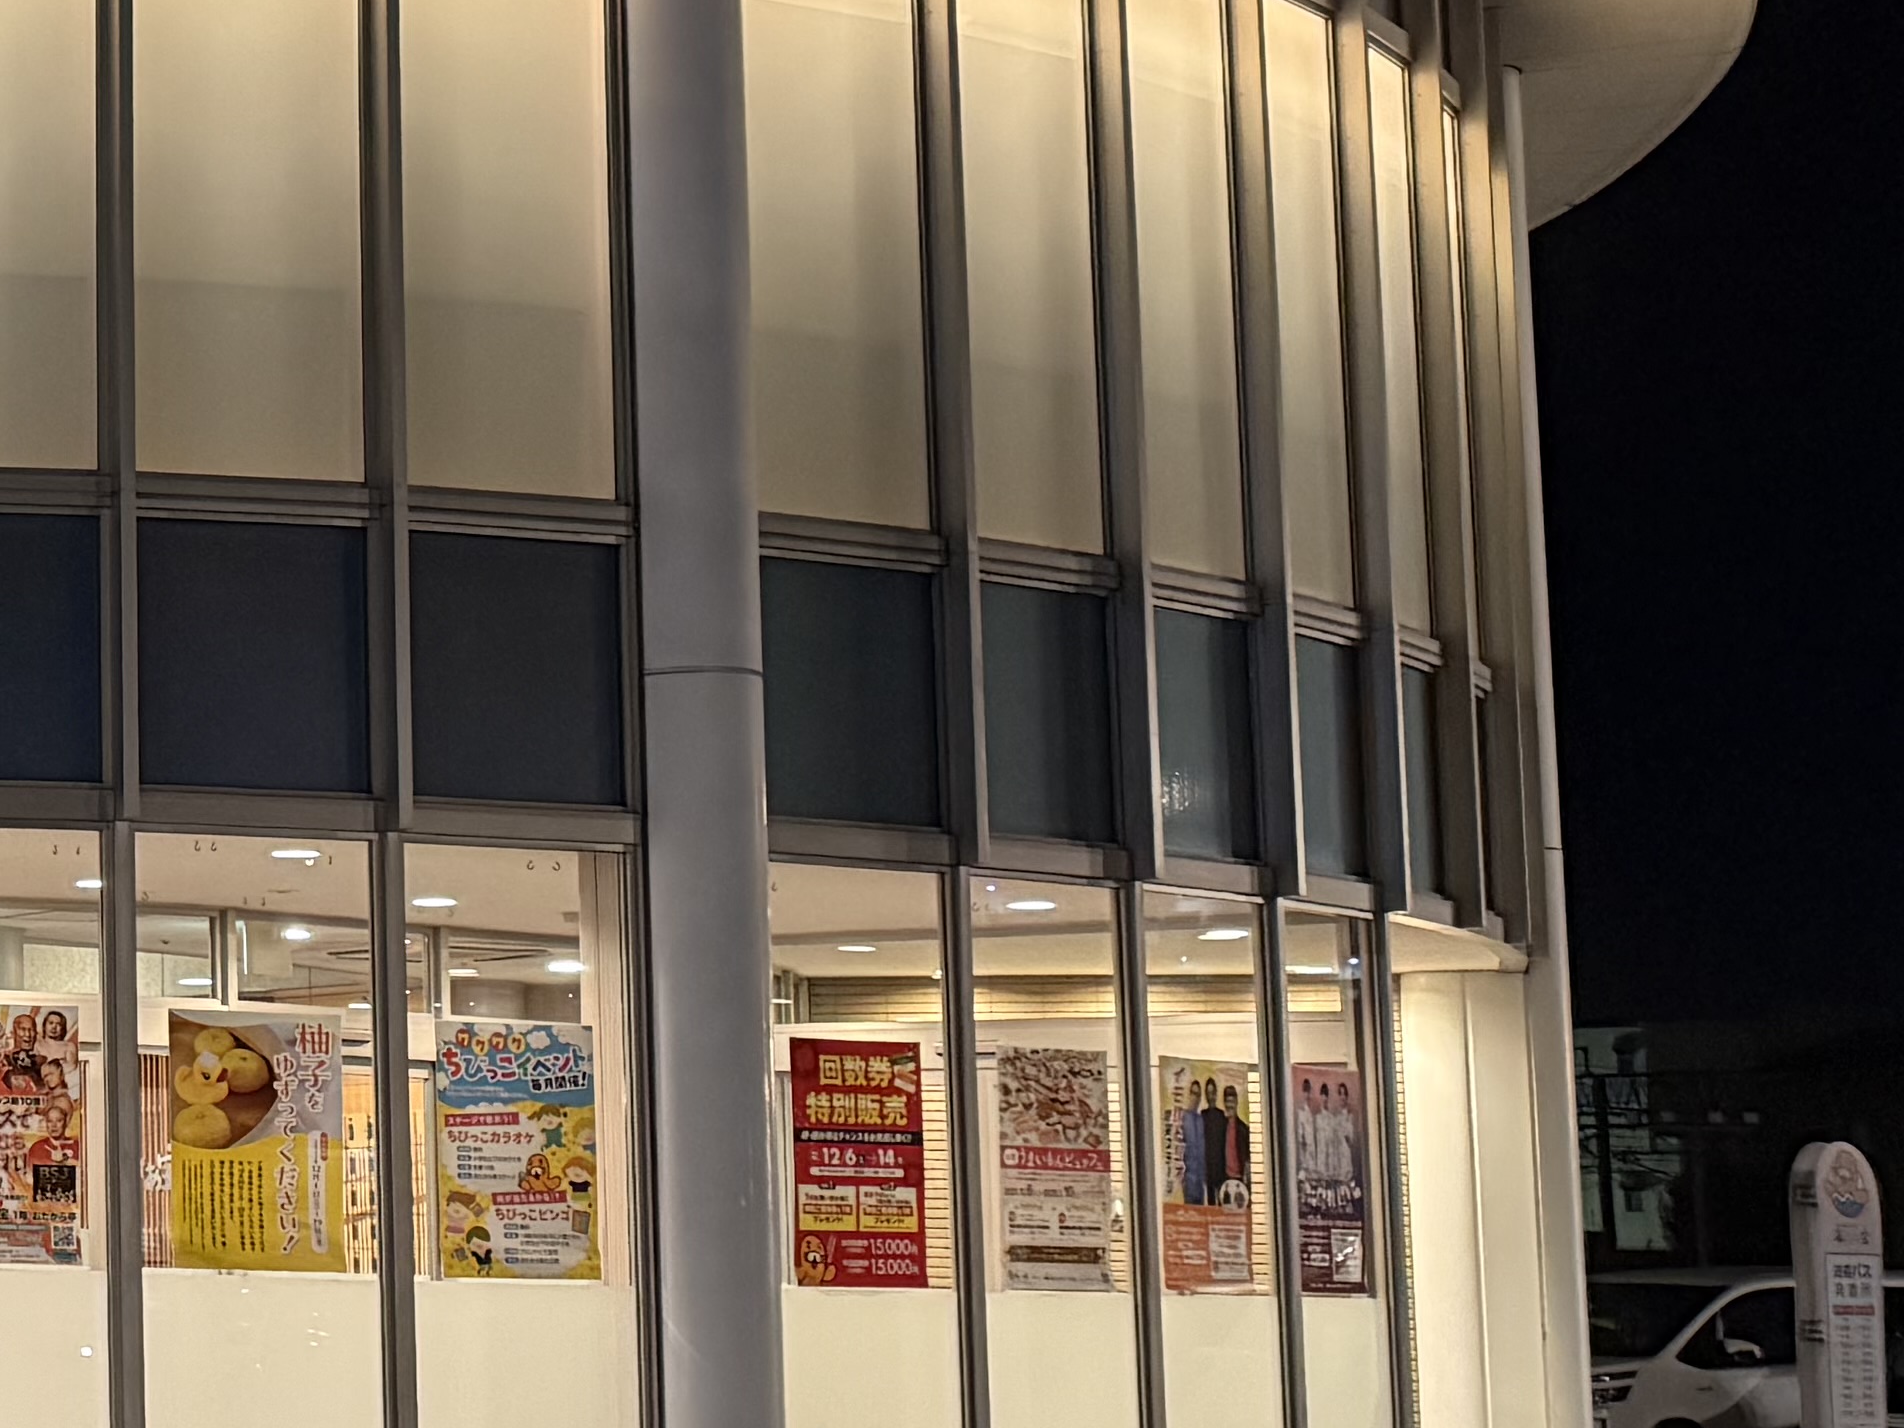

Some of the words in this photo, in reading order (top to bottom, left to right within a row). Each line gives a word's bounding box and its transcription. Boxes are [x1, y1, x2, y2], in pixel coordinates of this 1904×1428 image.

[457, 1032, 523, 1054] ワクワク
[297, 1023, 332, 1111] 柚子を
[442, 1046, 586, 1080] ちびっこイベント
[819, 1055, 892, 1087] 回数券
[531, 1071, 587, 1091] 毎月開催!
[806, 1092, 908, 1126] 特別販売
[274, 1054, 299, 1253] ゆずってください!
[448, 1130, 535, 1145] ちびっこカラオケ
[495, 1208, 570, 1222] ちびっこビンゴ
